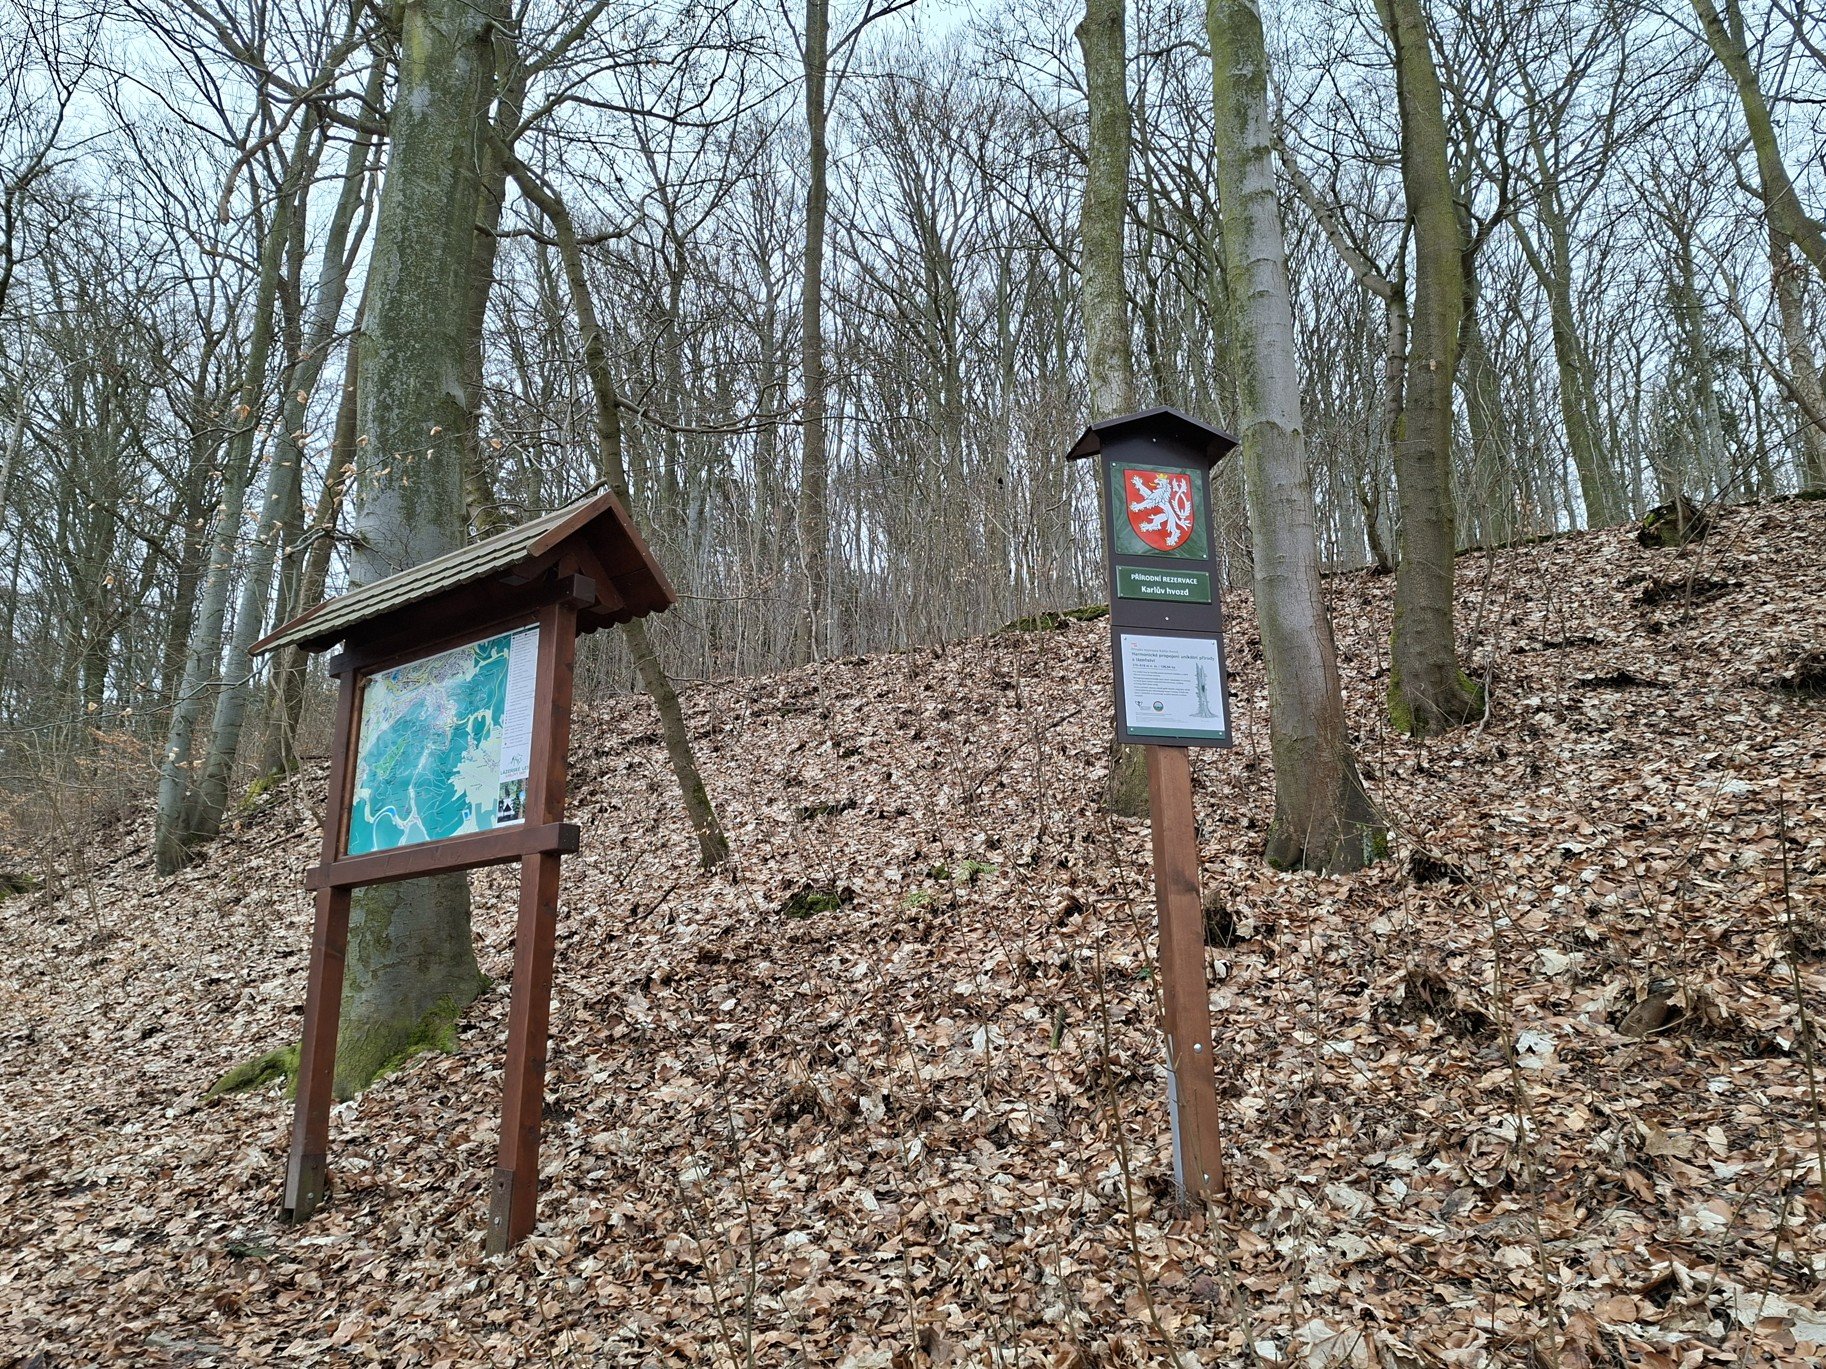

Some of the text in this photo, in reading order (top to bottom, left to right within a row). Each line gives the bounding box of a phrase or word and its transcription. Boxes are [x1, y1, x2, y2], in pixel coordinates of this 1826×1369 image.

[1131, 573, 1198, 585] PŘÍRODNÍ REZERVACE
[1141, 586, 1189, 596] Karlův hvozd
